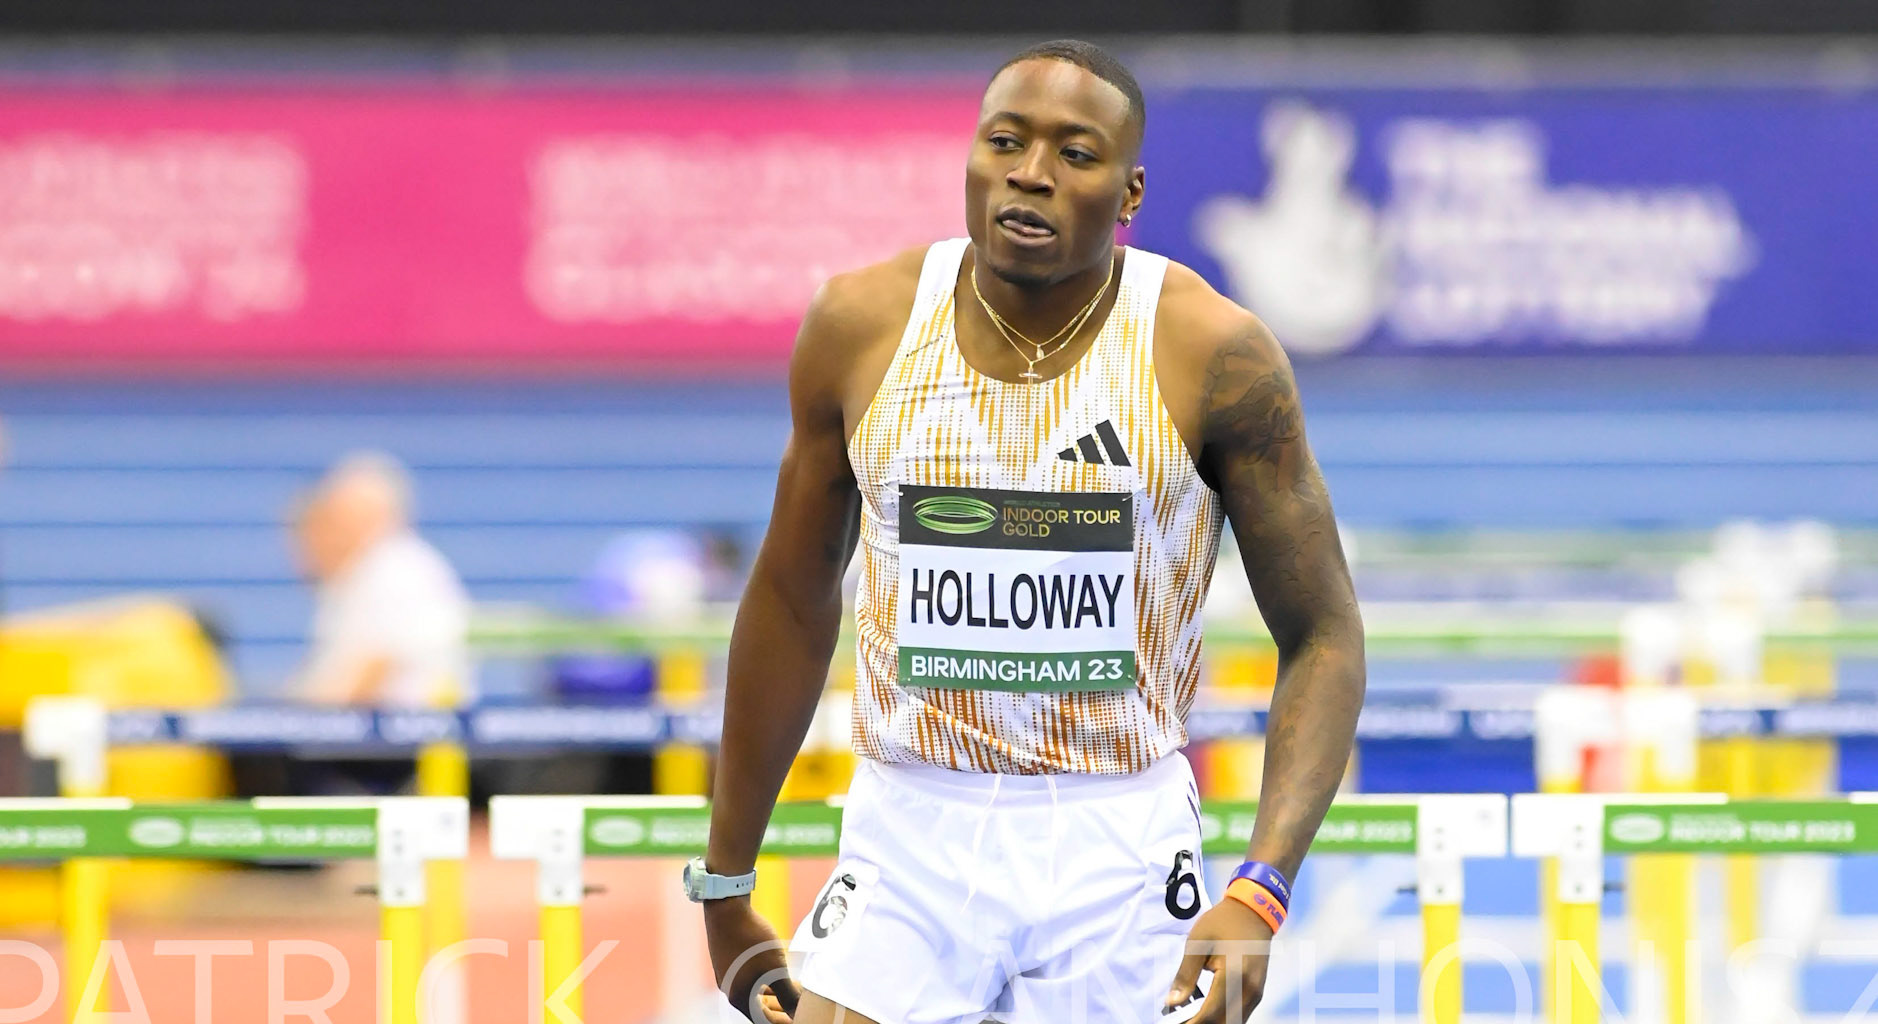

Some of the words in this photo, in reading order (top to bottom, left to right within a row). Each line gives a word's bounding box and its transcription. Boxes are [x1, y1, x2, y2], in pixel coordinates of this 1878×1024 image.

[1003, 507, 1069, 524] INDOOR
[1072, 509, 1121, 525] TOUR
[1003, 522, 1050, 538] GOLD
[911, 568, 1124, 630] HOLLOWAY
[911, 655, 1081, 682] BIRMINGHAM
[1088, 658, 1124, 681] 23
[1165, 849, 1201, 920] 6
